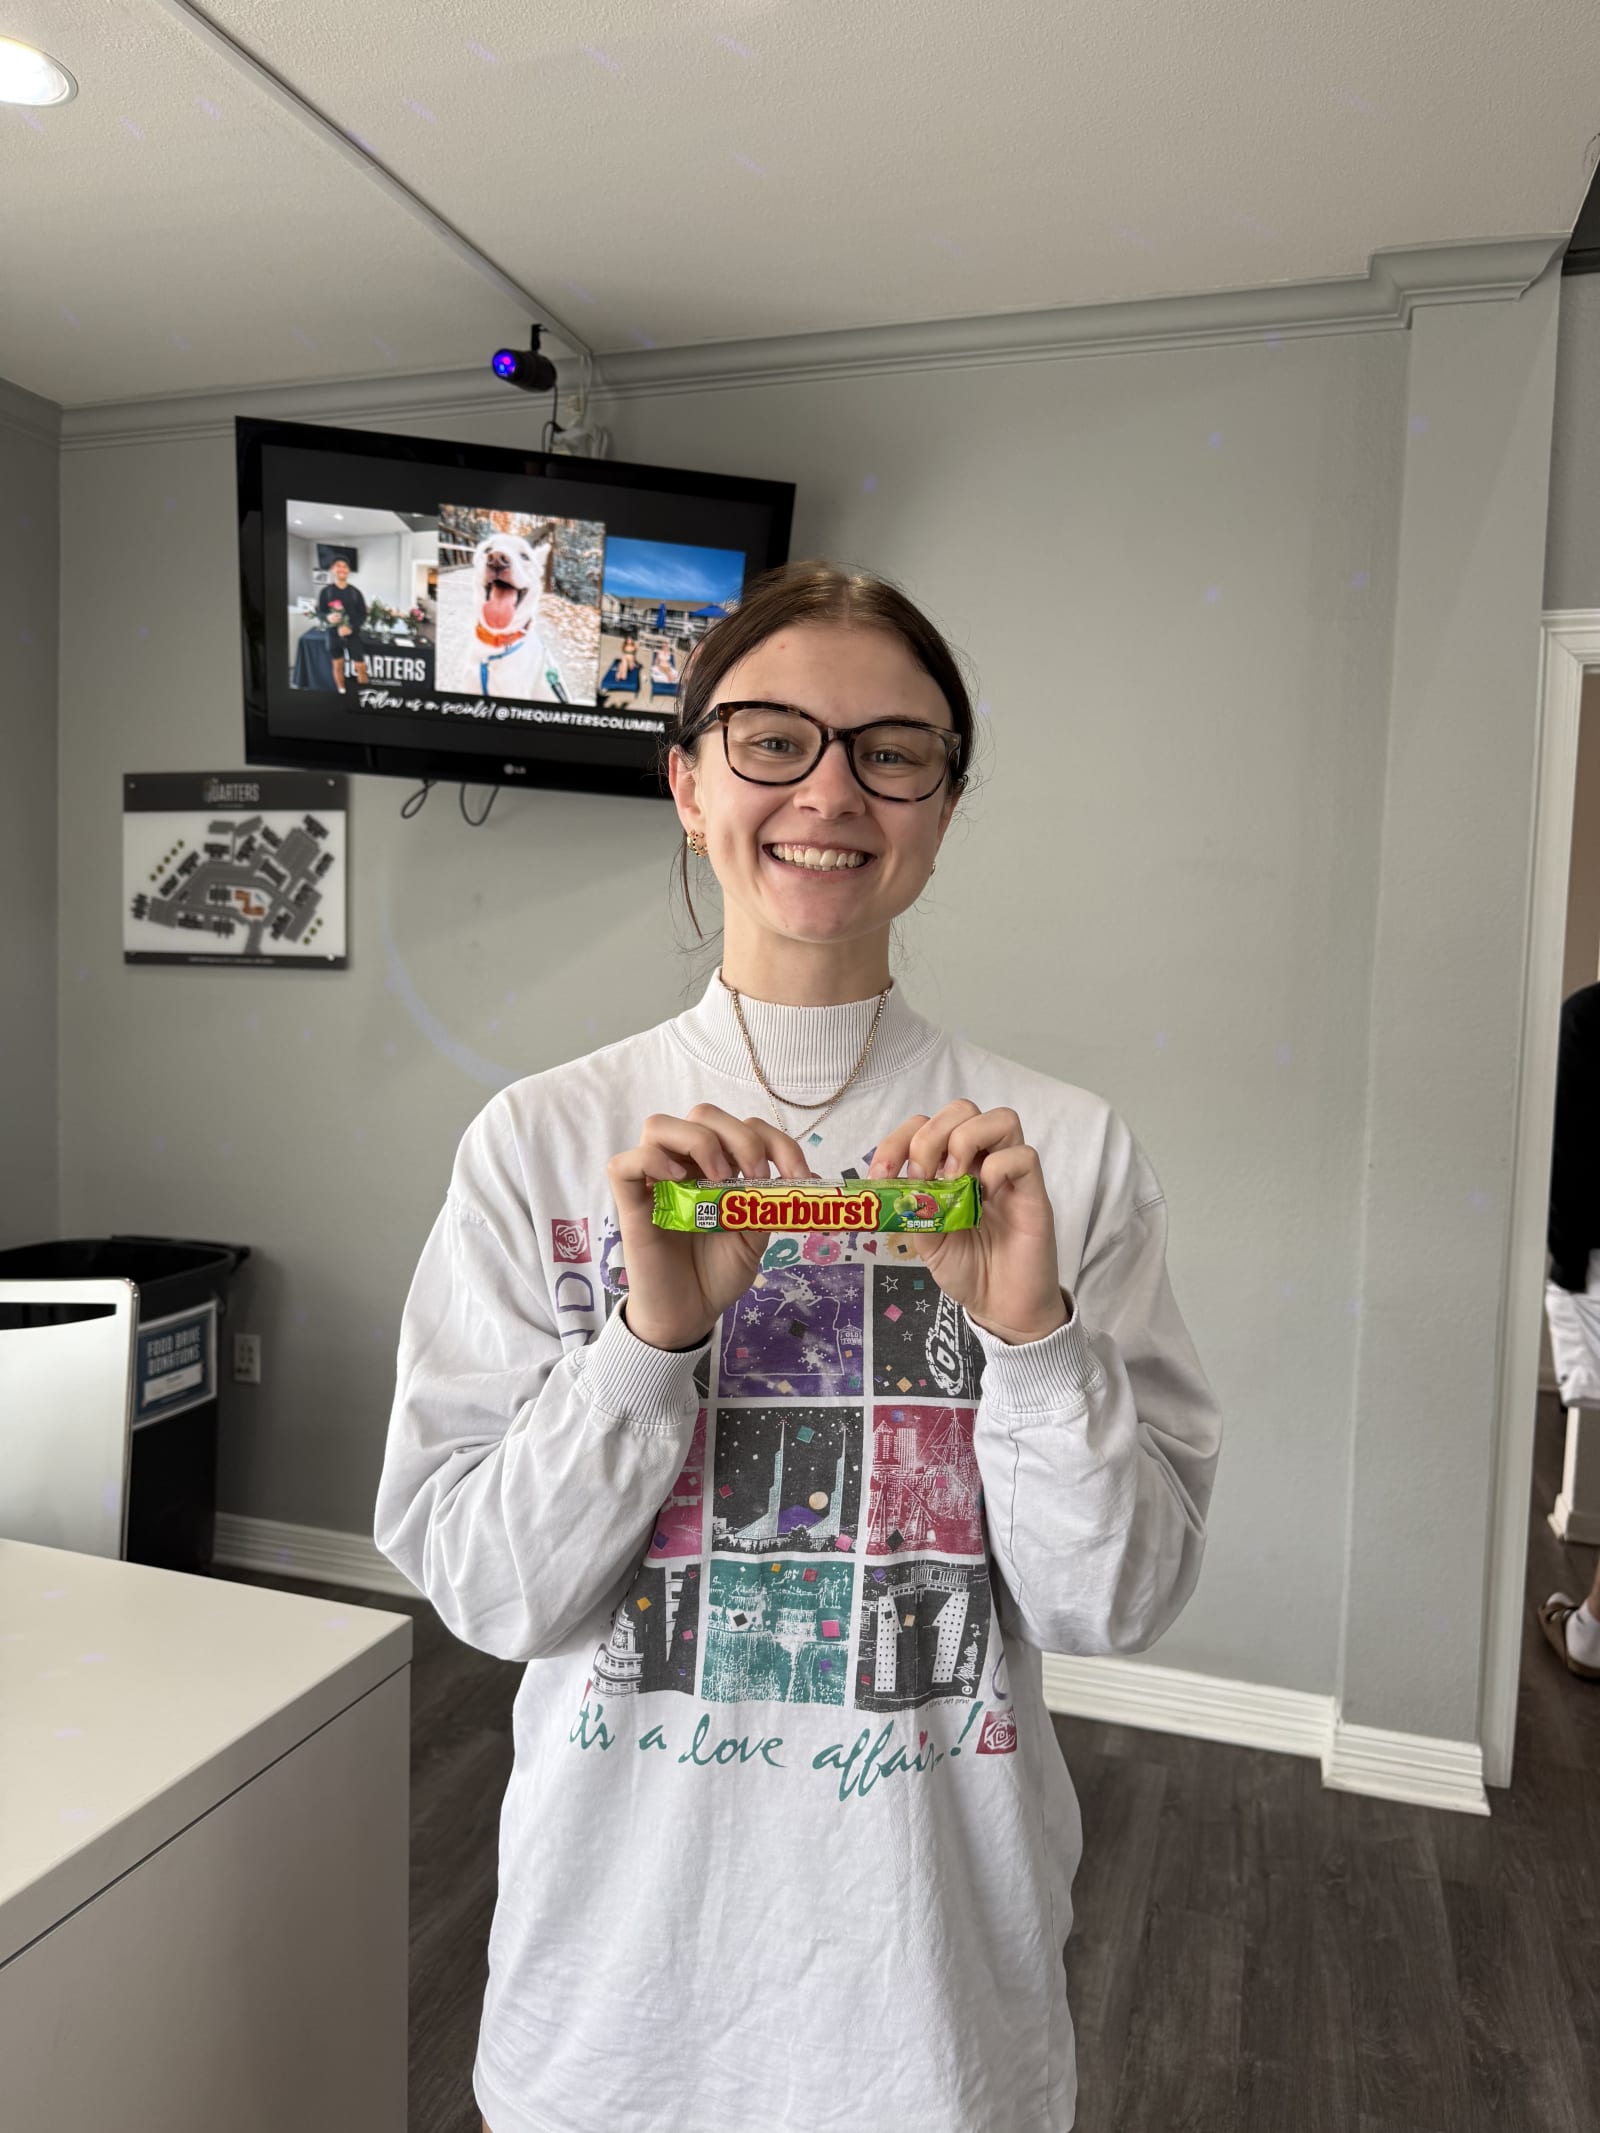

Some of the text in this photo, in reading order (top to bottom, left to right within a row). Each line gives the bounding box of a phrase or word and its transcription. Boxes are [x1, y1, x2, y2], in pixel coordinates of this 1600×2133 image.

[358, 688, 404, 710] Follow
[405, 697, 422, 711] us
[424, 700, 439, 711] on
[495, 706, 666, 733] @THEQUARTERSCOLUMBIA
[697, 1204, 716, 1216] 240
[726, 1195, 874, 1225] Starburst
[906, 1219, 934, 1229] SOUR
[147, 1326, 200, 1358] FOOD DRIVE
[147, 1343, 200, 1376] DONATIONS
[639, 1724, 667, 1750] a
[678, 1713, 787, 1768] love
